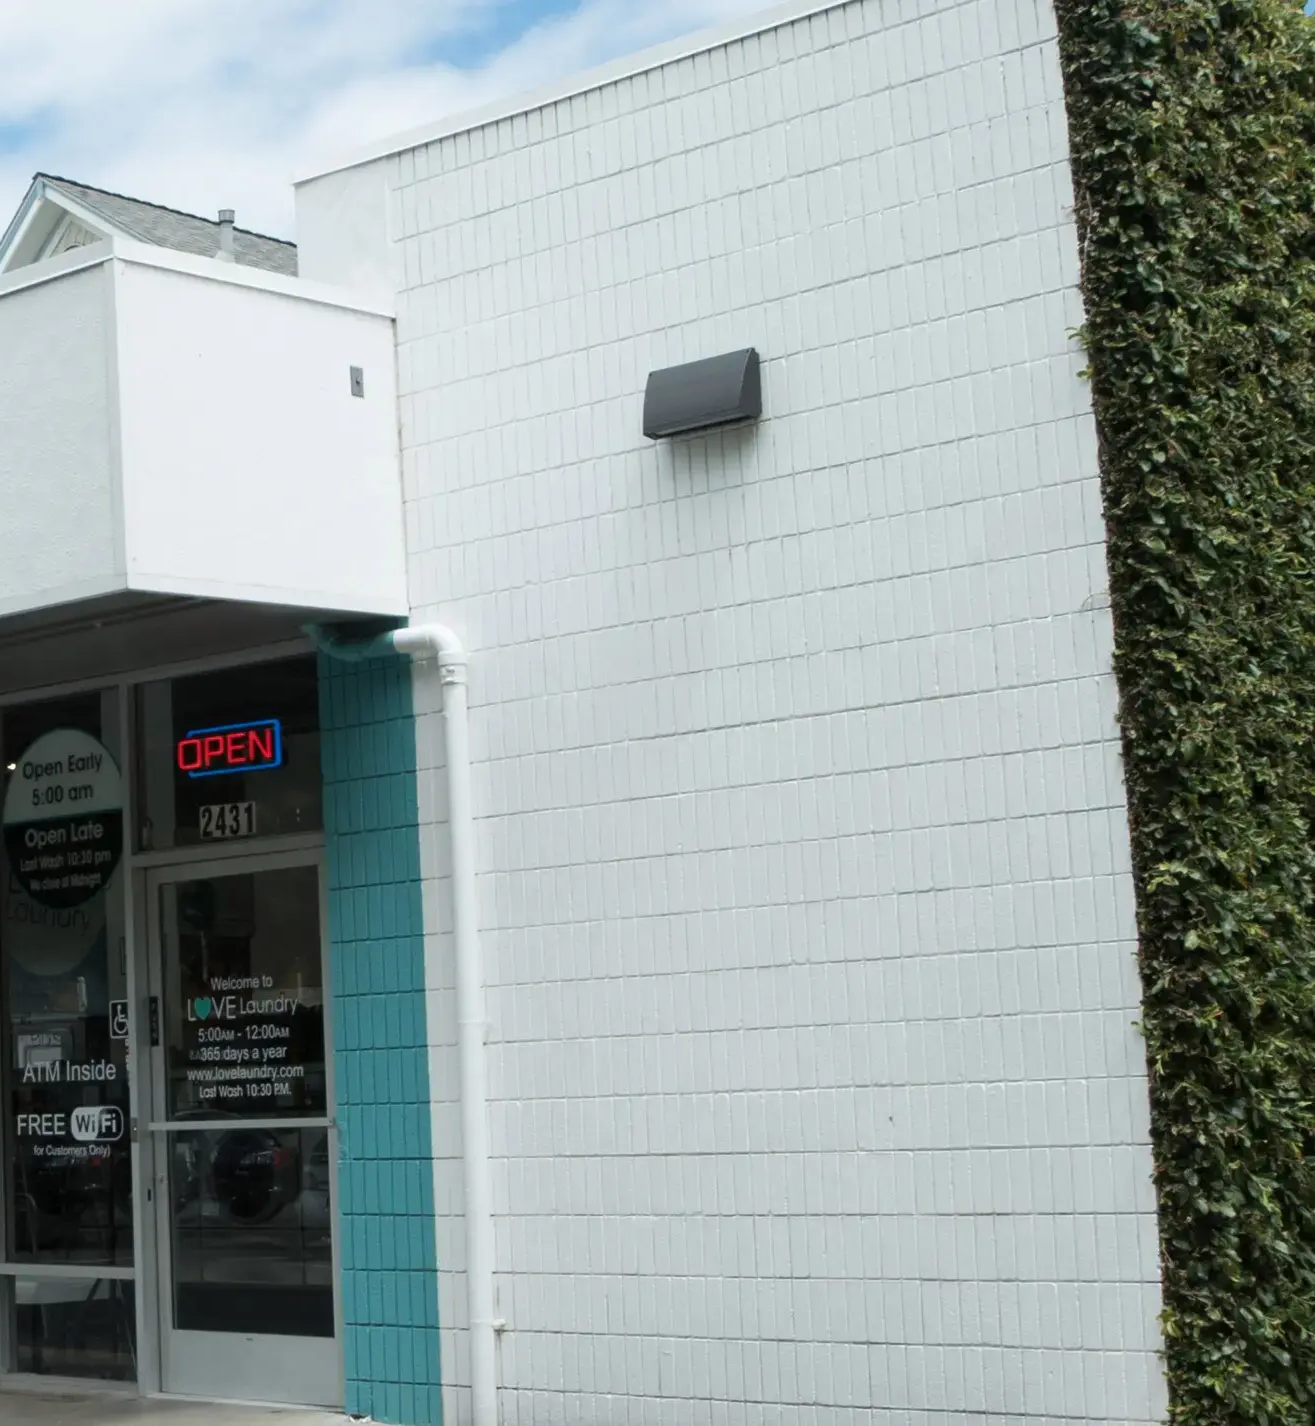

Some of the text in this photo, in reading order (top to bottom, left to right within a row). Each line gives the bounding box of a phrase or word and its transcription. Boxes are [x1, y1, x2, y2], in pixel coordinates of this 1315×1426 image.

[177, 727, 272, 771] OPEN
[22, 752, 103, 781] Open Early
[31, 784, 94, 806] 5:00 am
[201, 803, 253, 837] 2431
[24, 820, 104, 849] Open Late
[94, 850, 112, 866] pm
[210, 974, 273, 991] Welcome to
[240, 993, 299, 1015] Laundry
[197, 1027, 235, 1043] 5:00AM
[245, 1024, 290, 1041] 12:00AM
[199, 1046, 220, 1062] 365
[223, 1045, 249, 1063] days
[251, 1050, 260, 1061] a
[262, 1047, 288, 1063] year
[22, 1058, 117, 1083] ATM Inside
[186, 1064, 305, 1082] www.lovelaundry.com
[199, 1085, 217, 1099] Last
[218, 1084, 244, 1098] Wash
[246, 1082, 272, 1097] 10:30
[17, 1113, 66, 1136] FREE
[45, 1144, 87, 1157] Customers
